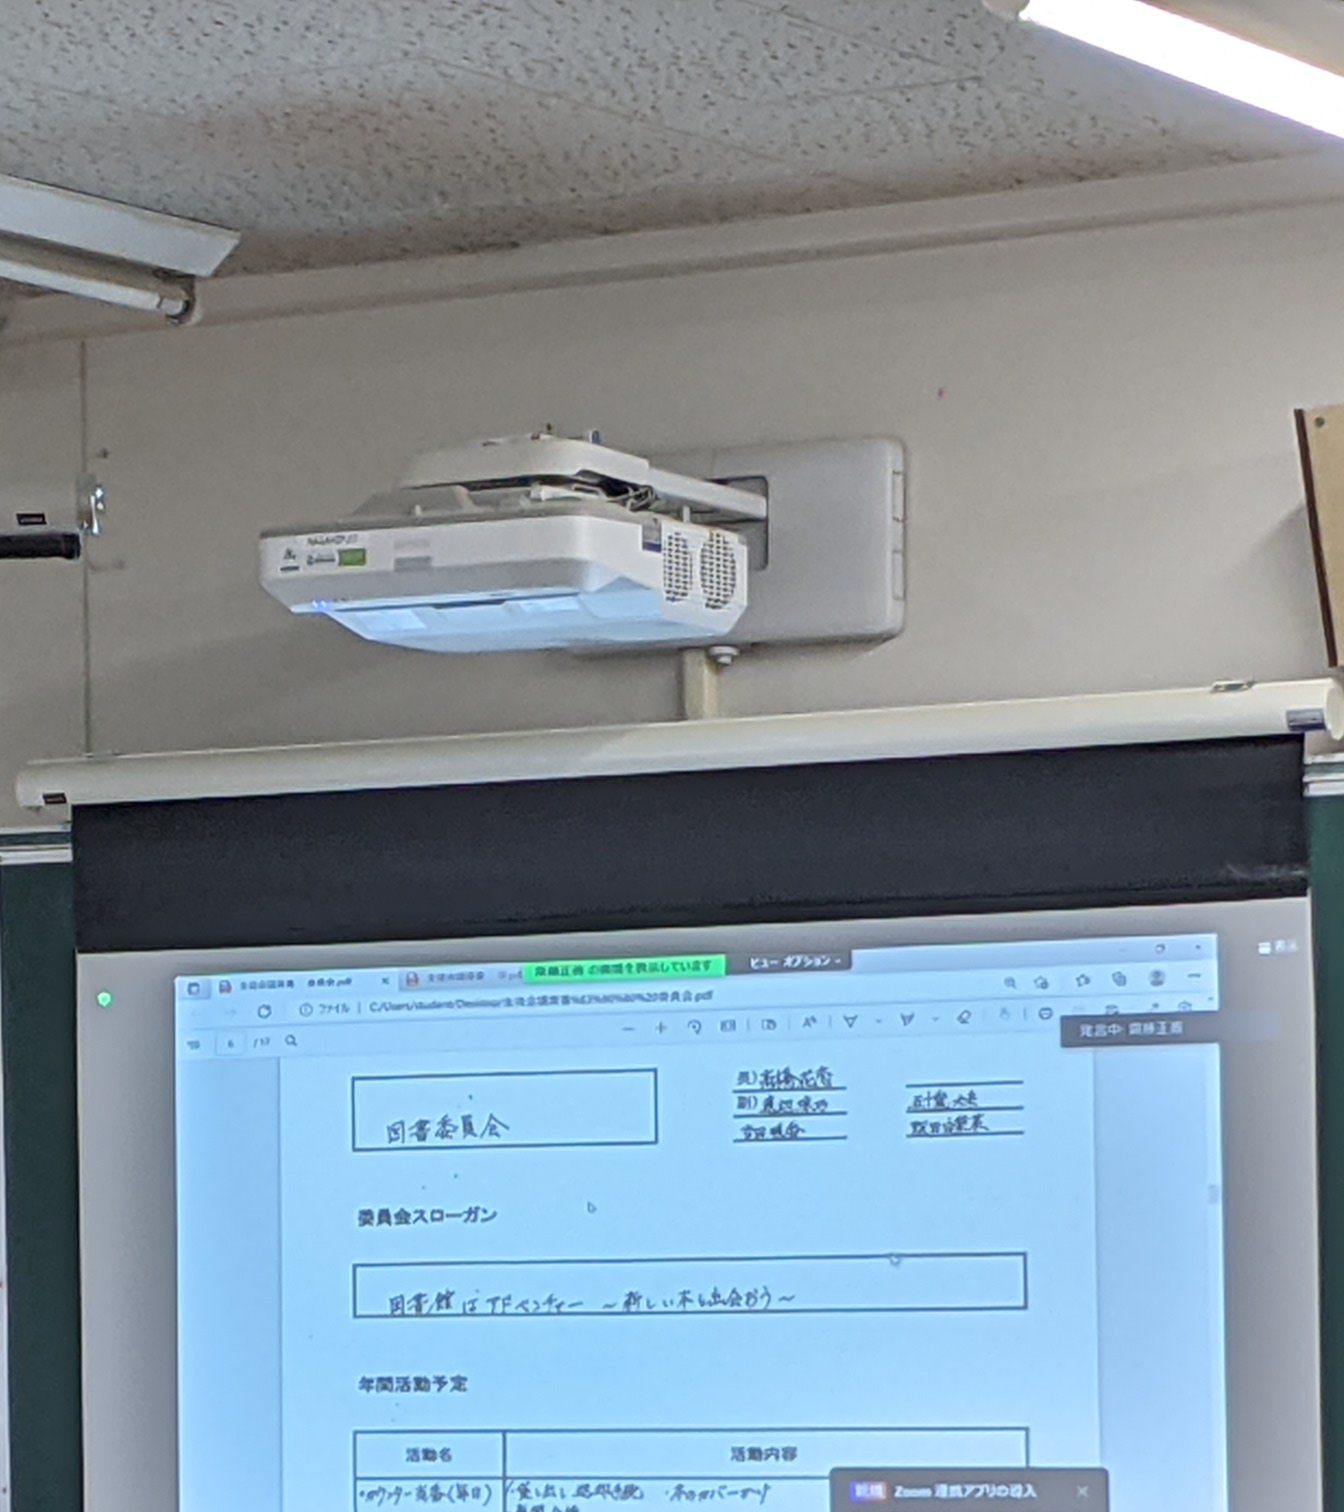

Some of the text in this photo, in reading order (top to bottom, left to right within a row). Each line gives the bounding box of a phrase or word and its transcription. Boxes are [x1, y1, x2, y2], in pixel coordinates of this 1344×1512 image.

[386, 1113, 510, 1144] 図書委員会
[358, 1205, 498, 1227] 委員会スローガン
[358, 1375, 469, 1394] 年間活動予定
[406, 1447, 452, 1462] 活動名
[730, 1446, 798, 1462] 活動内容
[893, 1484, 932, 1498] Zoom
